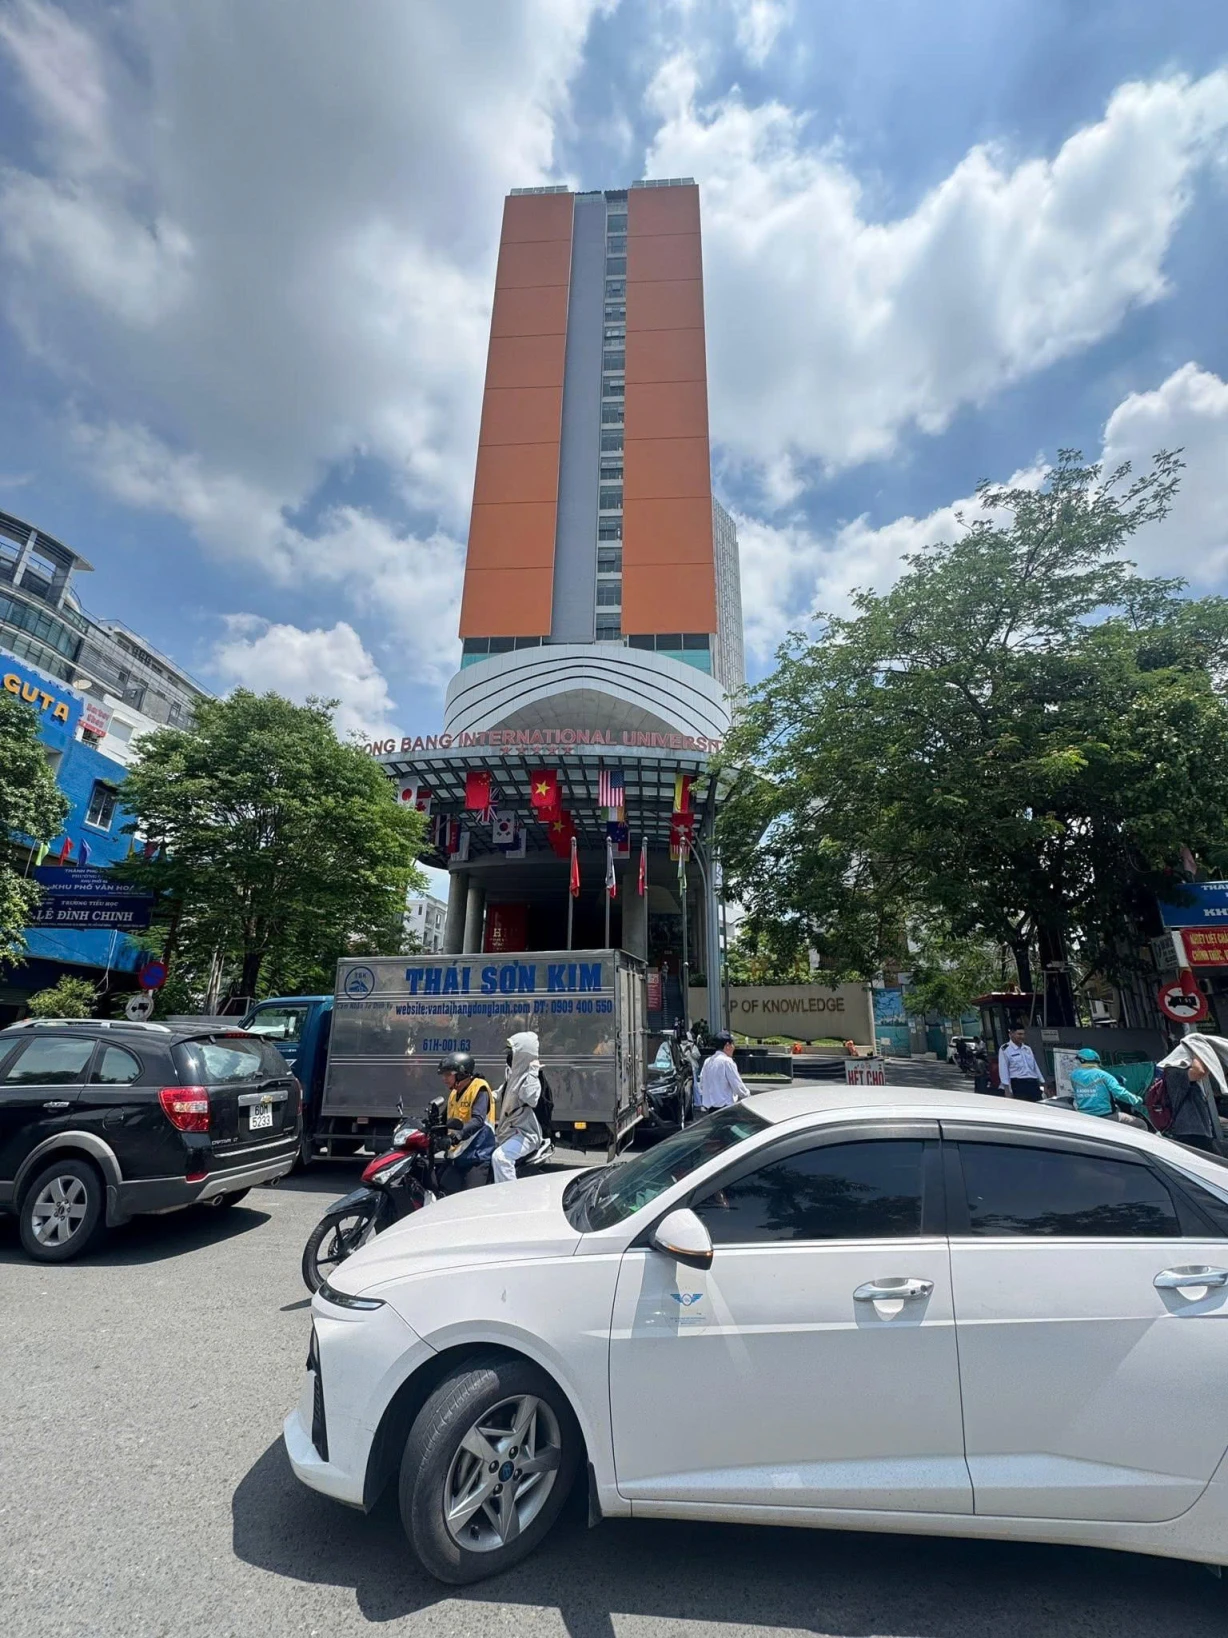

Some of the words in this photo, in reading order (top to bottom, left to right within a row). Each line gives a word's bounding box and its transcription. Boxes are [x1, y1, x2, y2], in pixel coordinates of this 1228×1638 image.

[358, 738, 396, 756] ONG
[401, 733, 453, 753] BANG
[459, 729, 617, 748] INTERNATIONAL
[623, 730, 723, 753] UNIVERSIT
[74, 882, 93, 890] PHỐ
[57, 907, 89, 921] ĐÌNH
[92, 911, 134, 921] CHINH
[405, 959, 471, 995] THÁI
[481, 960, 536, 995] SƠN
[547, 963, 602, 992] KIM
[551, 1000, 573, 1013] 0909
[576, 1000, 593, 1013] 400
[595, 1000, 613, 1013] 550
[741, 999, 759, 1013] OF
[762, 997, 845, 1013] KNOWLEDGE
[423, 1039, 471, 1052] 61H-001.63
[252, 1115, 270, 1128] 5233
